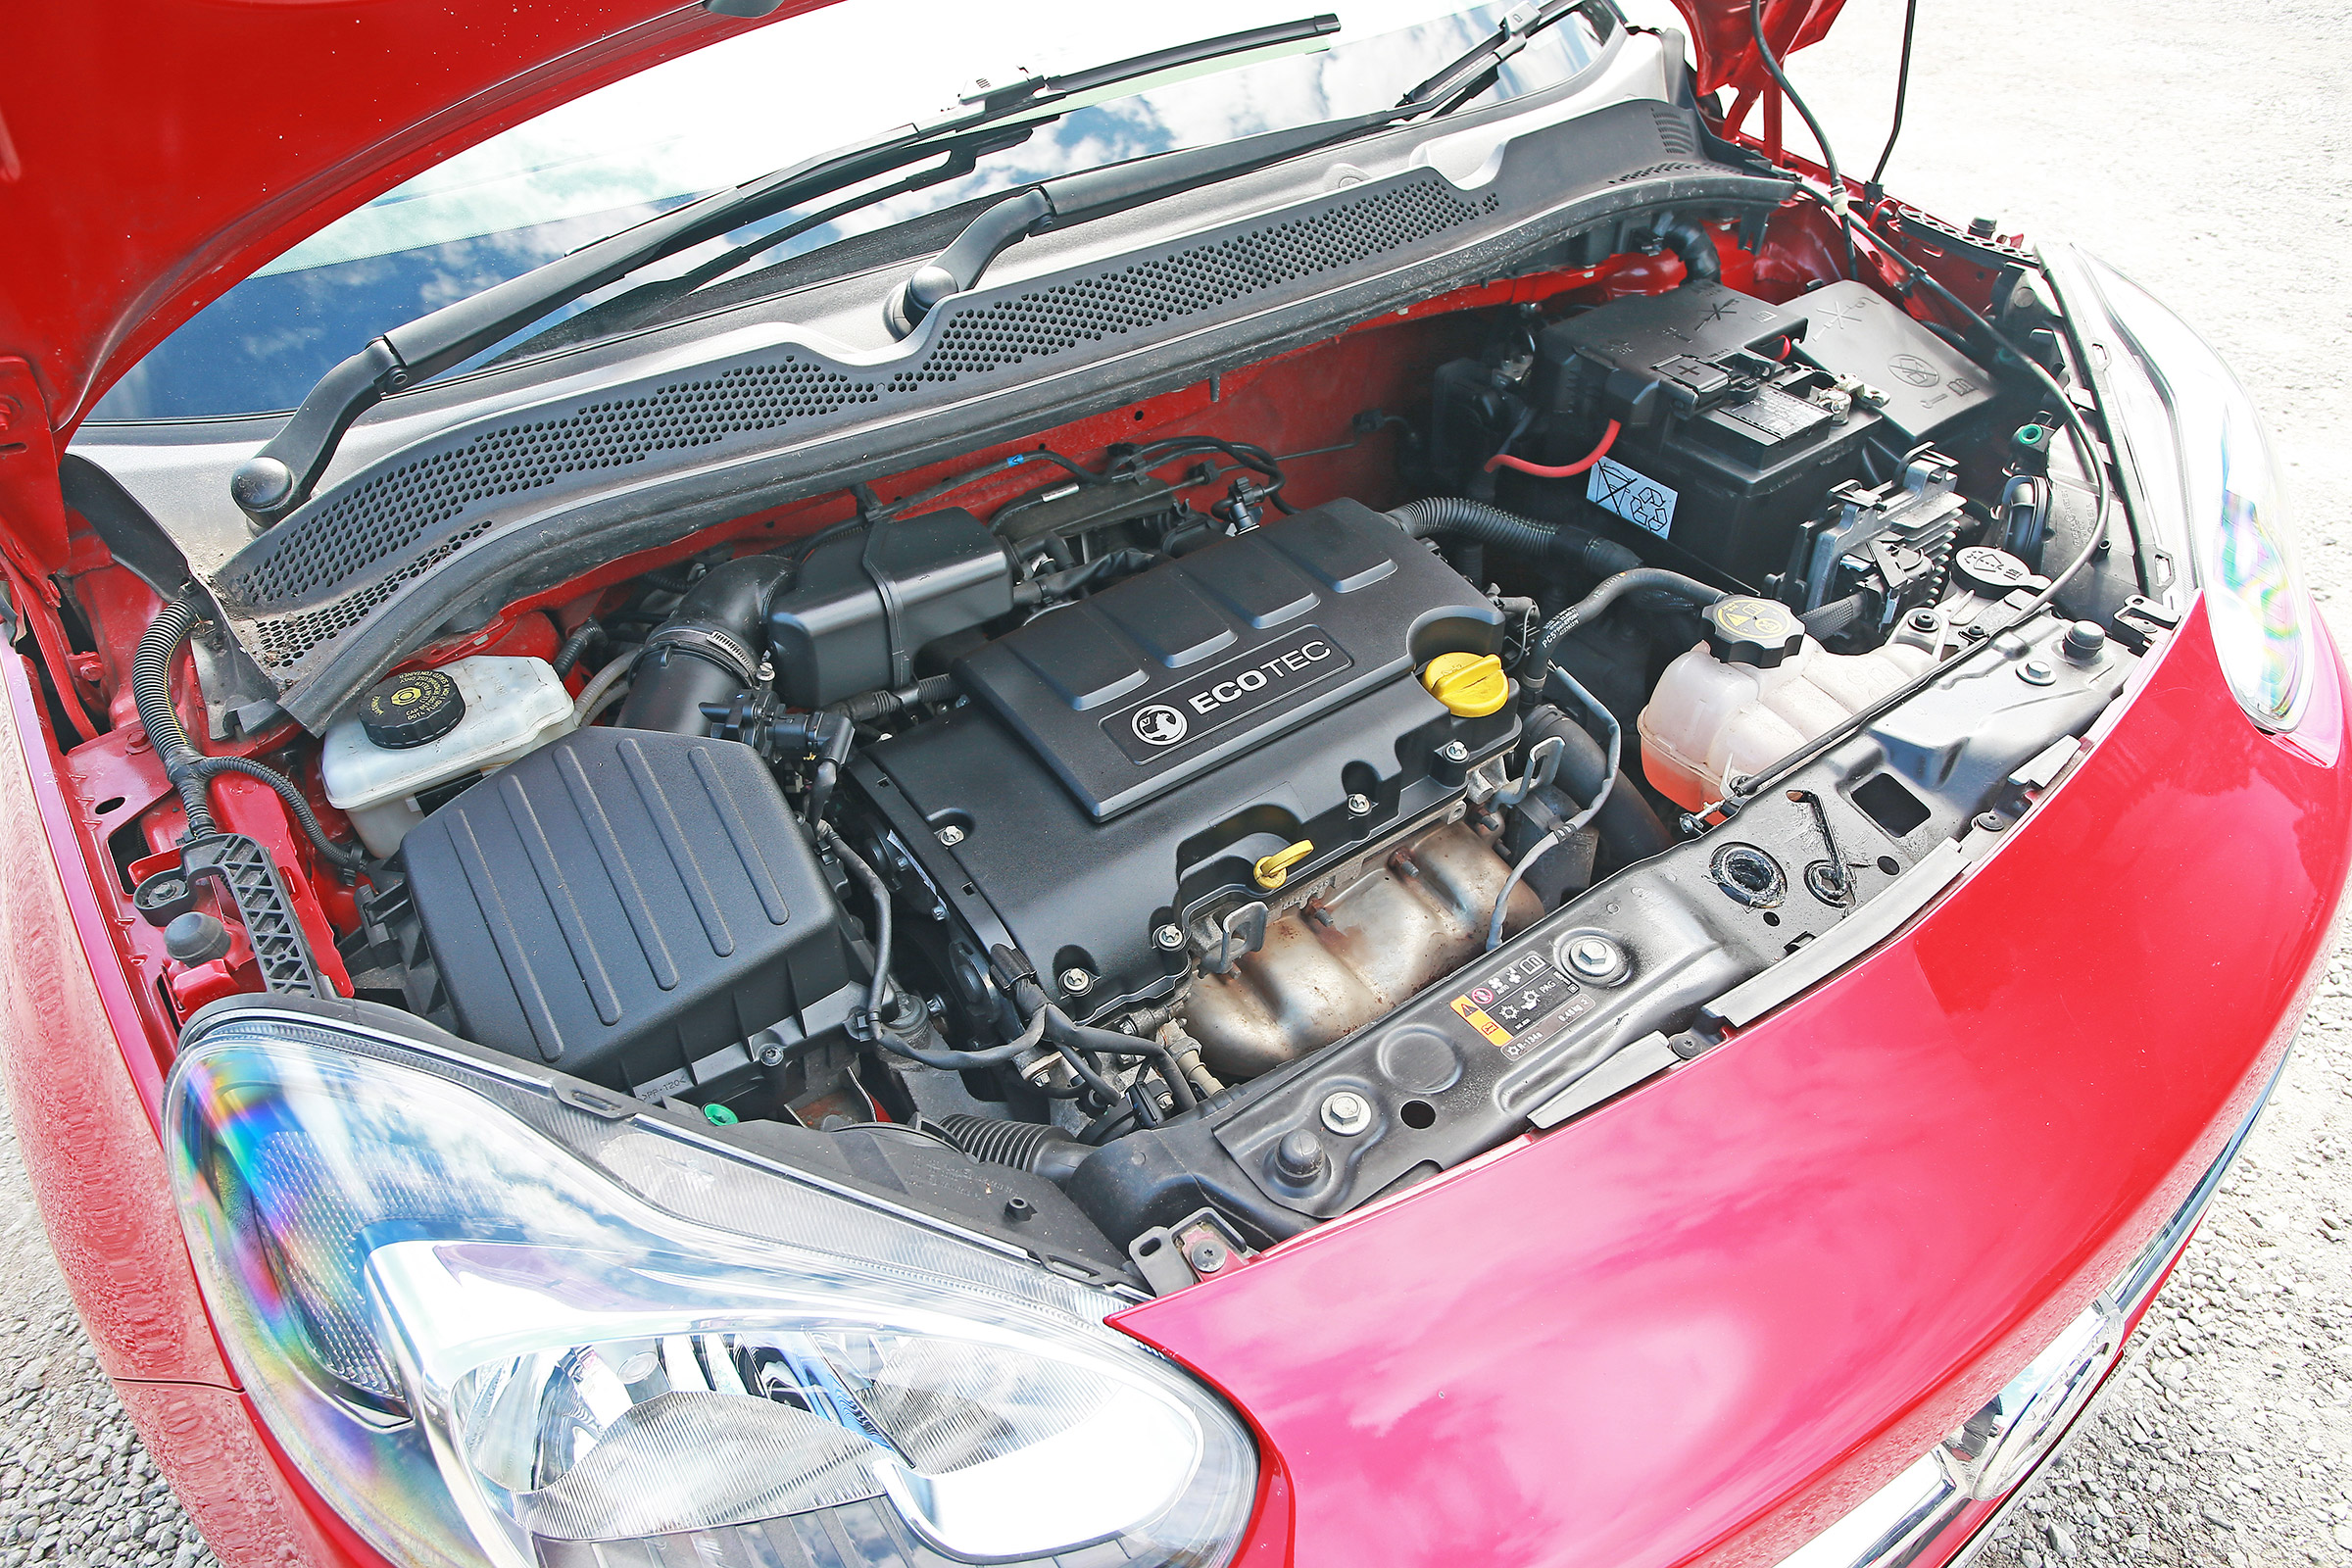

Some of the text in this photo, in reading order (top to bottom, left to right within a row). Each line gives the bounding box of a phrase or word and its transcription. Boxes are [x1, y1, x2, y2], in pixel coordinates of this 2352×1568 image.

[1187, 640, 1331, 715] ECOTEC
[1495, 984, 1510, 996] AUTO
[1539, 980, 1556, 995] PAG
[1518, 1032, 1544, 1051] R-134a
